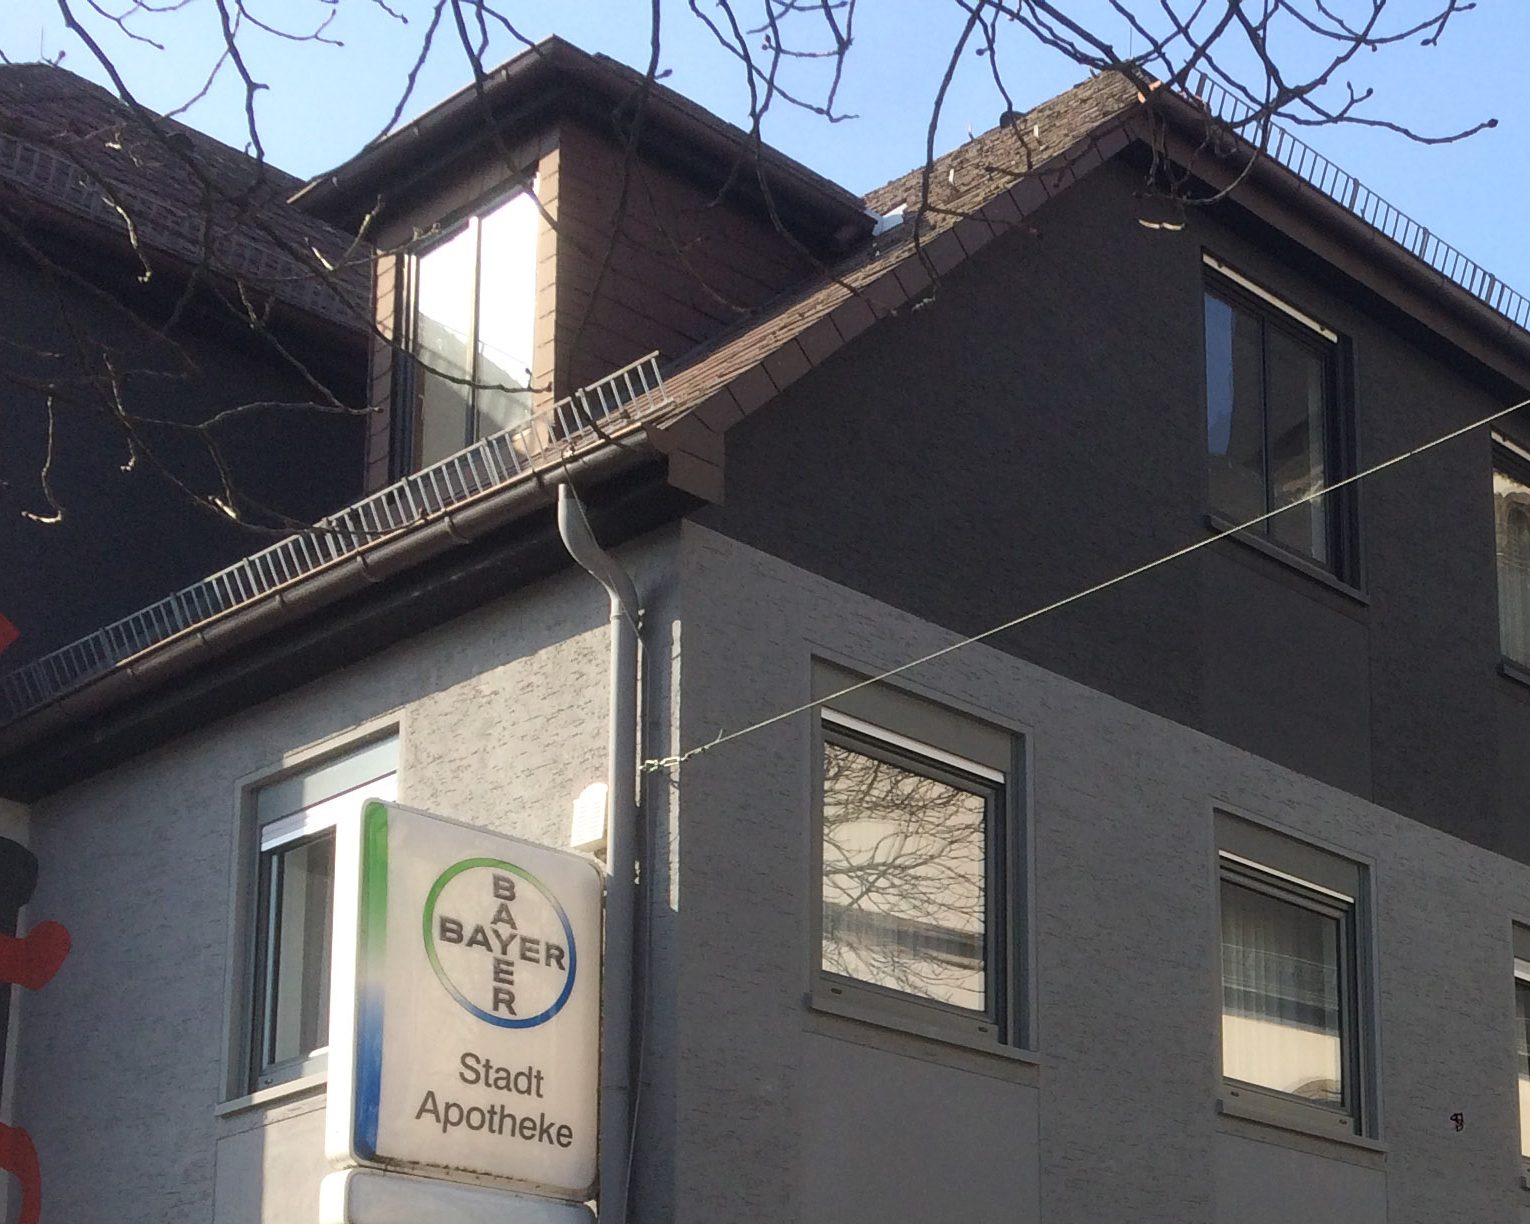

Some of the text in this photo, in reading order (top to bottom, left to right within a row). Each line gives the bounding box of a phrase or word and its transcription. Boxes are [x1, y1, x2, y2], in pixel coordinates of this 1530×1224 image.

[438, 914, 566, 971] BAYER
[490, 872, 517, 1016] BAYER
[458, 1051, 544, 1099] Stadt
[415, 1089, 574, 1149] Apotheke
